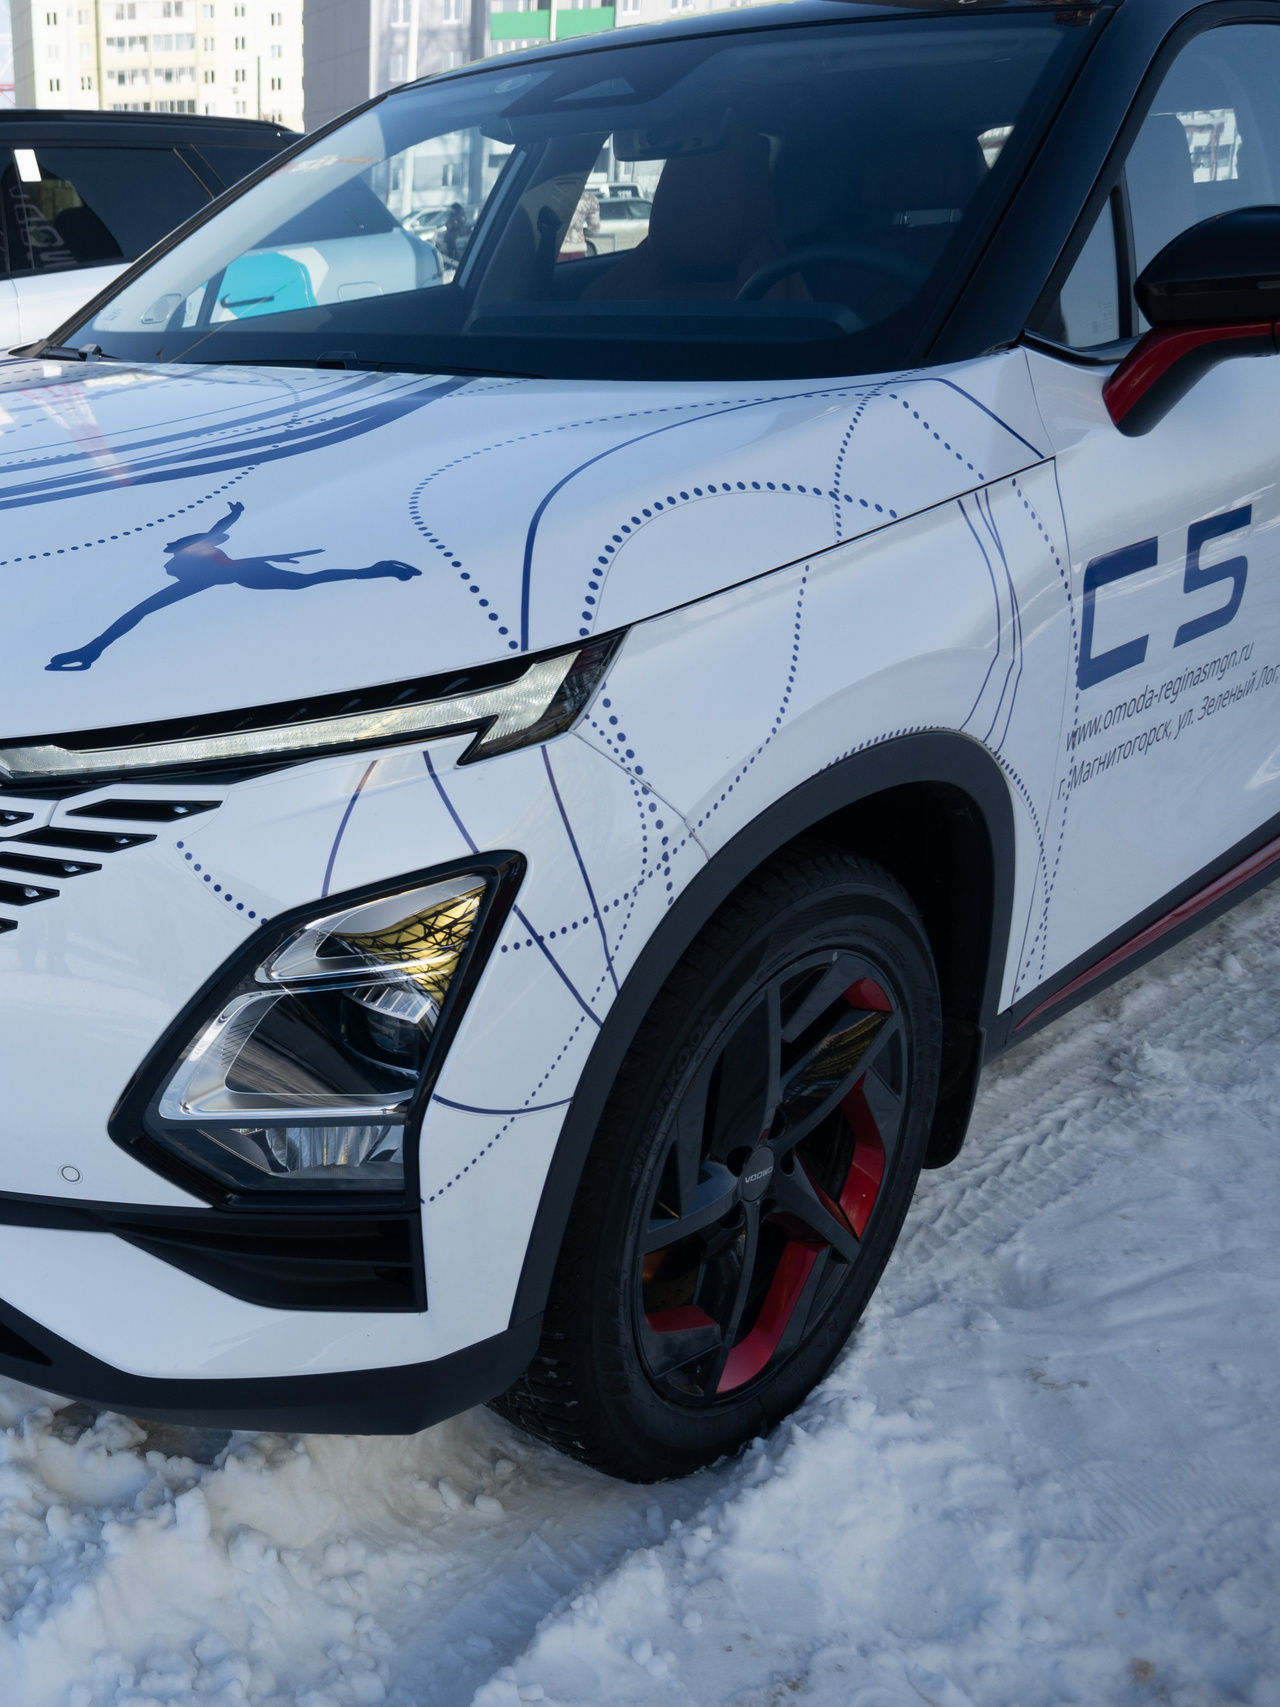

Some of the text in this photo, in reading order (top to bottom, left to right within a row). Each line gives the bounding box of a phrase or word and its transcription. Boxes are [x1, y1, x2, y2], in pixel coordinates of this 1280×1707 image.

[1066, 642, 1255, 752] www.omoda-reginasmgn.ru
[1070, 719, 1173, 792] Магнитогорск,
[1173, 707, 1194, 740] ул.
[1197, 669, 1258, 721] Зеленый
